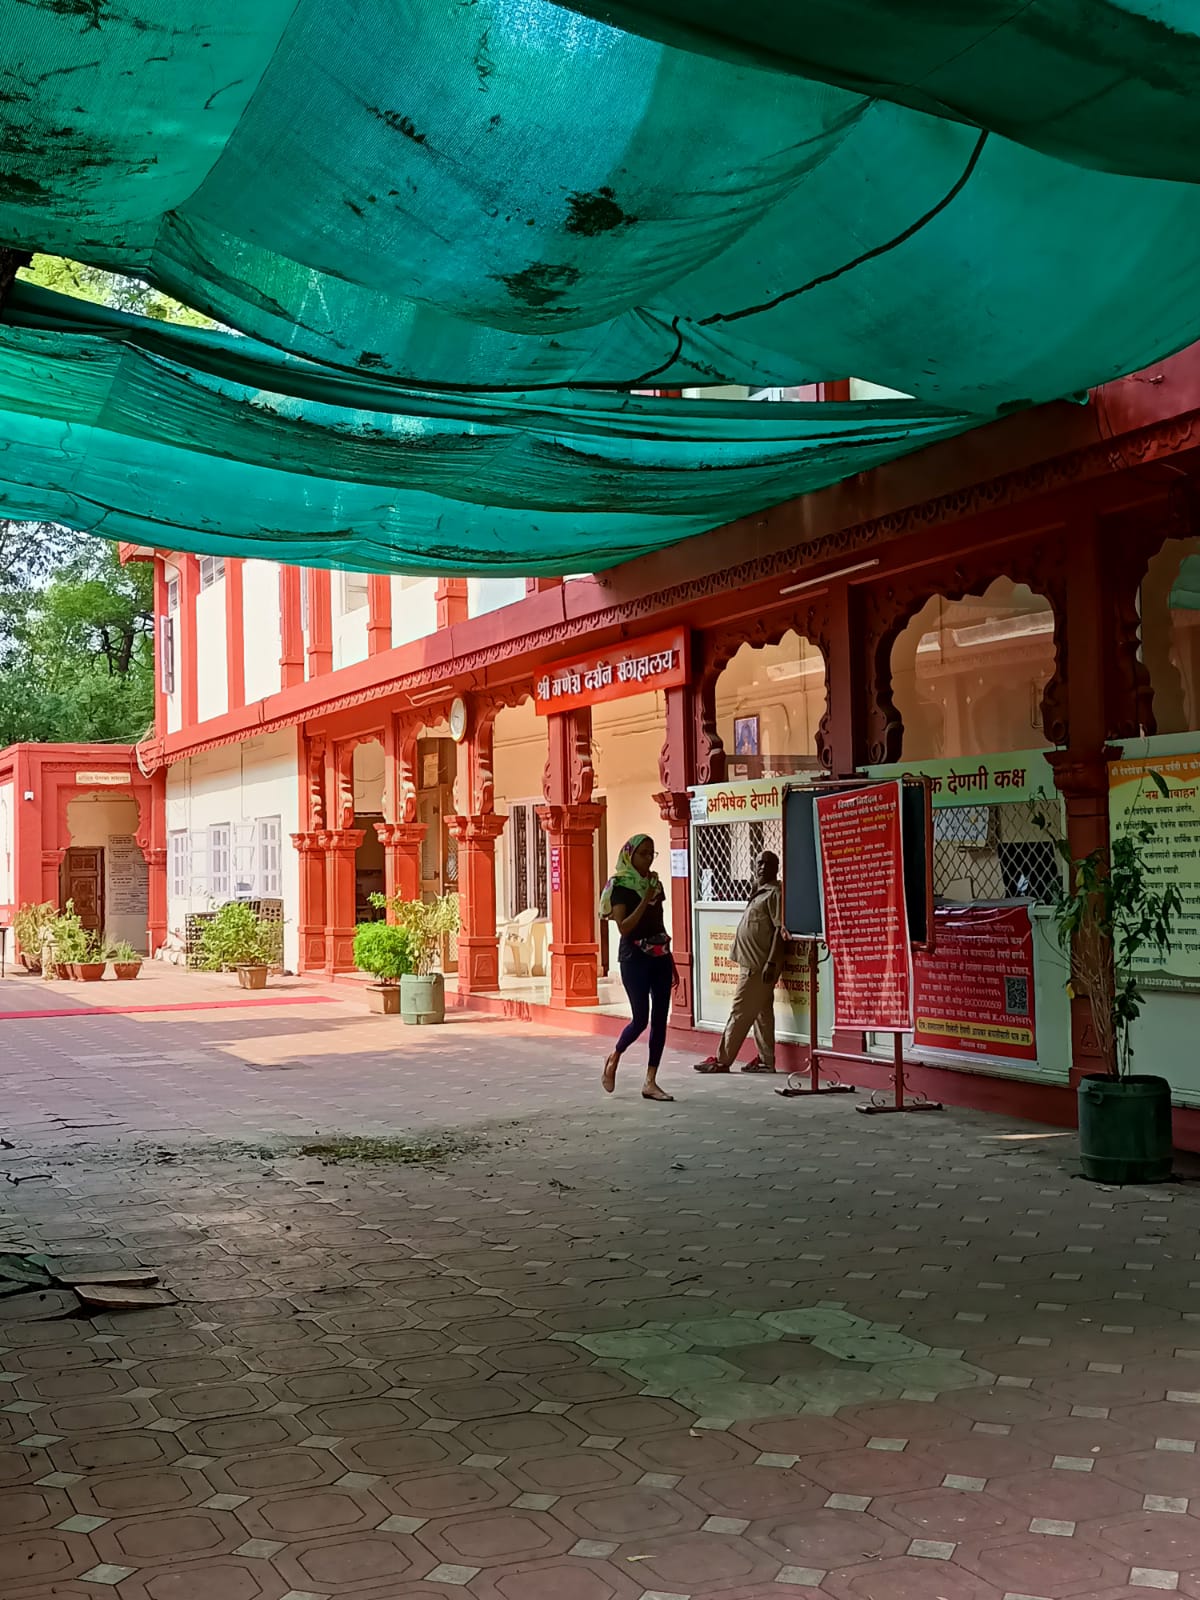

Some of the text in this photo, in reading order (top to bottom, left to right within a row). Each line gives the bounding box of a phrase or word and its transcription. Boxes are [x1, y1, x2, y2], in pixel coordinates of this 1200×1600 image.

[537, 650, 674, 700] श्री गणेश दर्शन संग्रहालय
[947, 765, 989, 795] देणगी
[993, 769, 1026, 788] कक्ष
[708, 790, 747, 813] अभिषेक
[750, 785, 779, 811] देणगी
